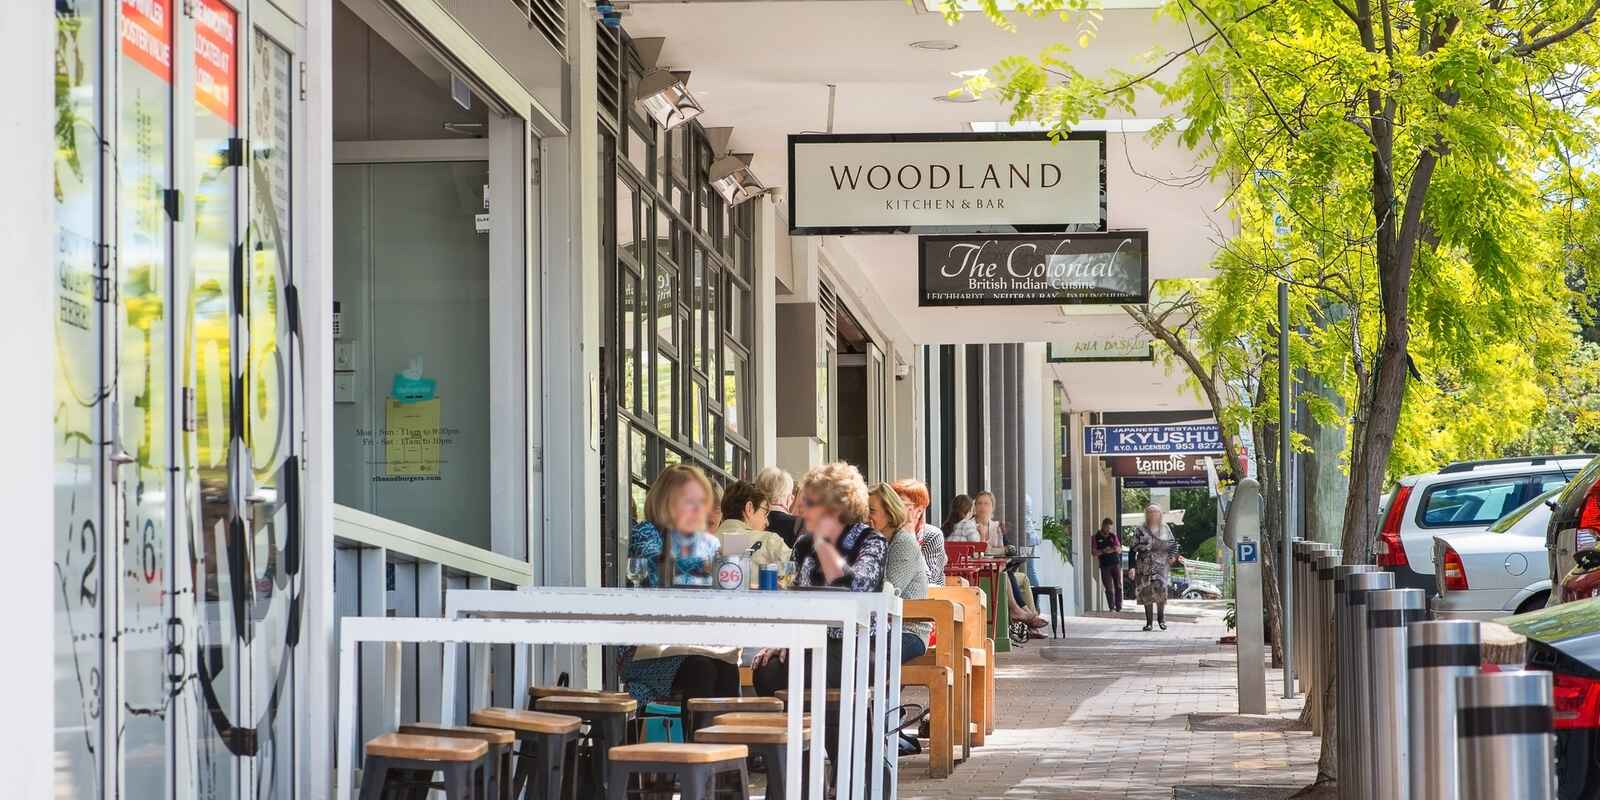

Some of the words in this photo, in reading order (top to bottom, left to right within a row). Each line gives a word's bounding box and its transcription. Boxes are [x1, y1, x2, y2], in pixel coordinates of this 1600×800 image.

[829, 163, 1062, 190] WOODLAND
[886, 199, 955, 210] KITCHEN
[961, 199, 971, 209] &
[976, 199, 1006, 209] BAR
[941, 239, 998, 278] The
[1006, 239, 1132, 278] Colonial
[968, 277, 1007, 290] British
[1011, 277, 1048, 290] Indian
[1052, 277, 1096, 290] Cuisine
[1119, 431, 1219, 444] KYUSHU
[1136, 456, 1185, 474] temple
[1241, 544, 1253, 561] P
[720, 569, 740, 582] 26
